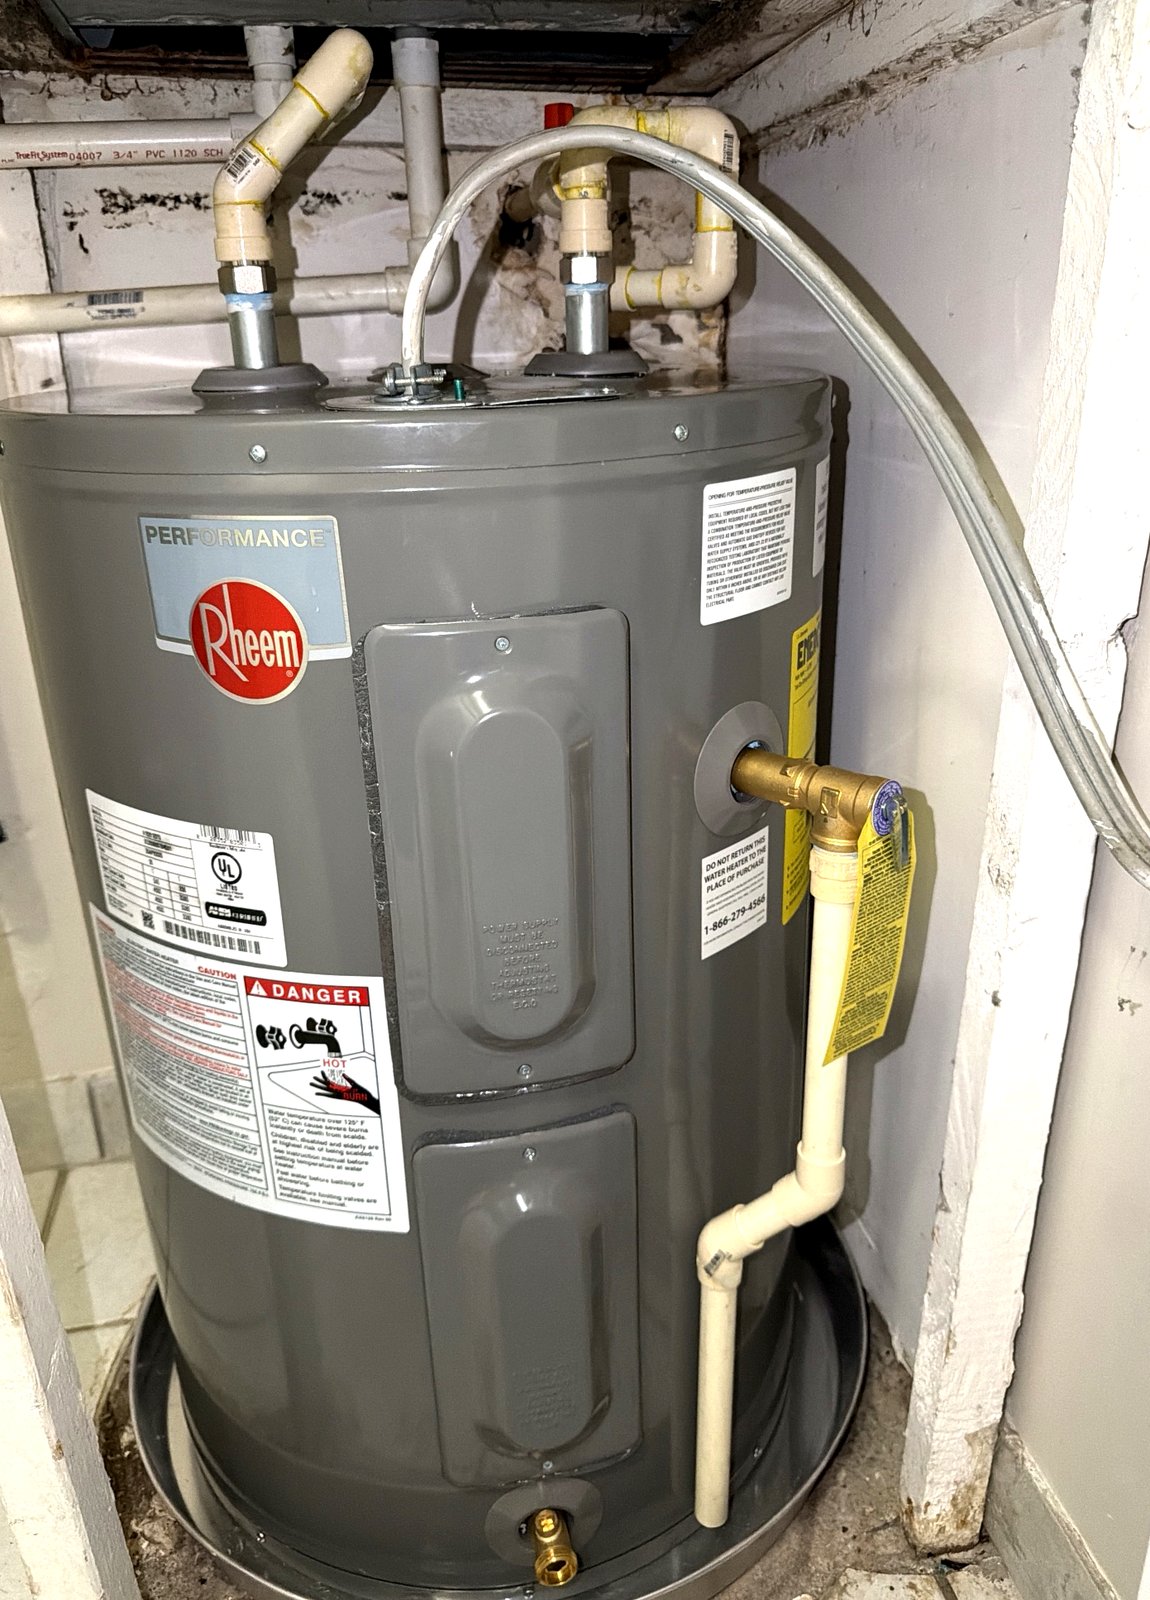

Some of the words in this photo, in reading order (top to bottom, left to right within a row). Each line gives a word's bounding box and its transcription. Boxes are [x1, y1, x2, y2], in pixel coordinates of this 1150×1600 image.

[69, 151, 102, 161] 04007
[146, 150, 166, 159] PVC
[173, 149, 198, 158] 1120
[203, 148, 223, 157] SCH
[708, 492, 726, 500] OPENING
[145, 525, 326, 548] PERFORMANCE
[199, 583, 300, 682] Rheem
[704, 868, 725, 883] WATER
[726, 856, 749, 873] HEATER
[749, 852, 756, 861] TO
[756, 845, 766, 856] THE
[706, 862, 716, 872] DO
[717, 854, 730, 866] NOT
[731, 843, 753, 860] RETURN
[753, 835, 766, 847] THIS
[706, 878, 726, 893] PLACE
[727, 873, 735, 883] OF
[736, 857, 765, 878] PURCHASE
[704, 893, 766, 935] 1-866-279-4566
[197, 966, 237, 980] CAUTION
[272, 983, 361, 1004] DANGER
[323, 1059, 347, 1068] HOT
[343, 1092, 368, 1101] BURN
[286, 1112, 325, 1122] temperature
